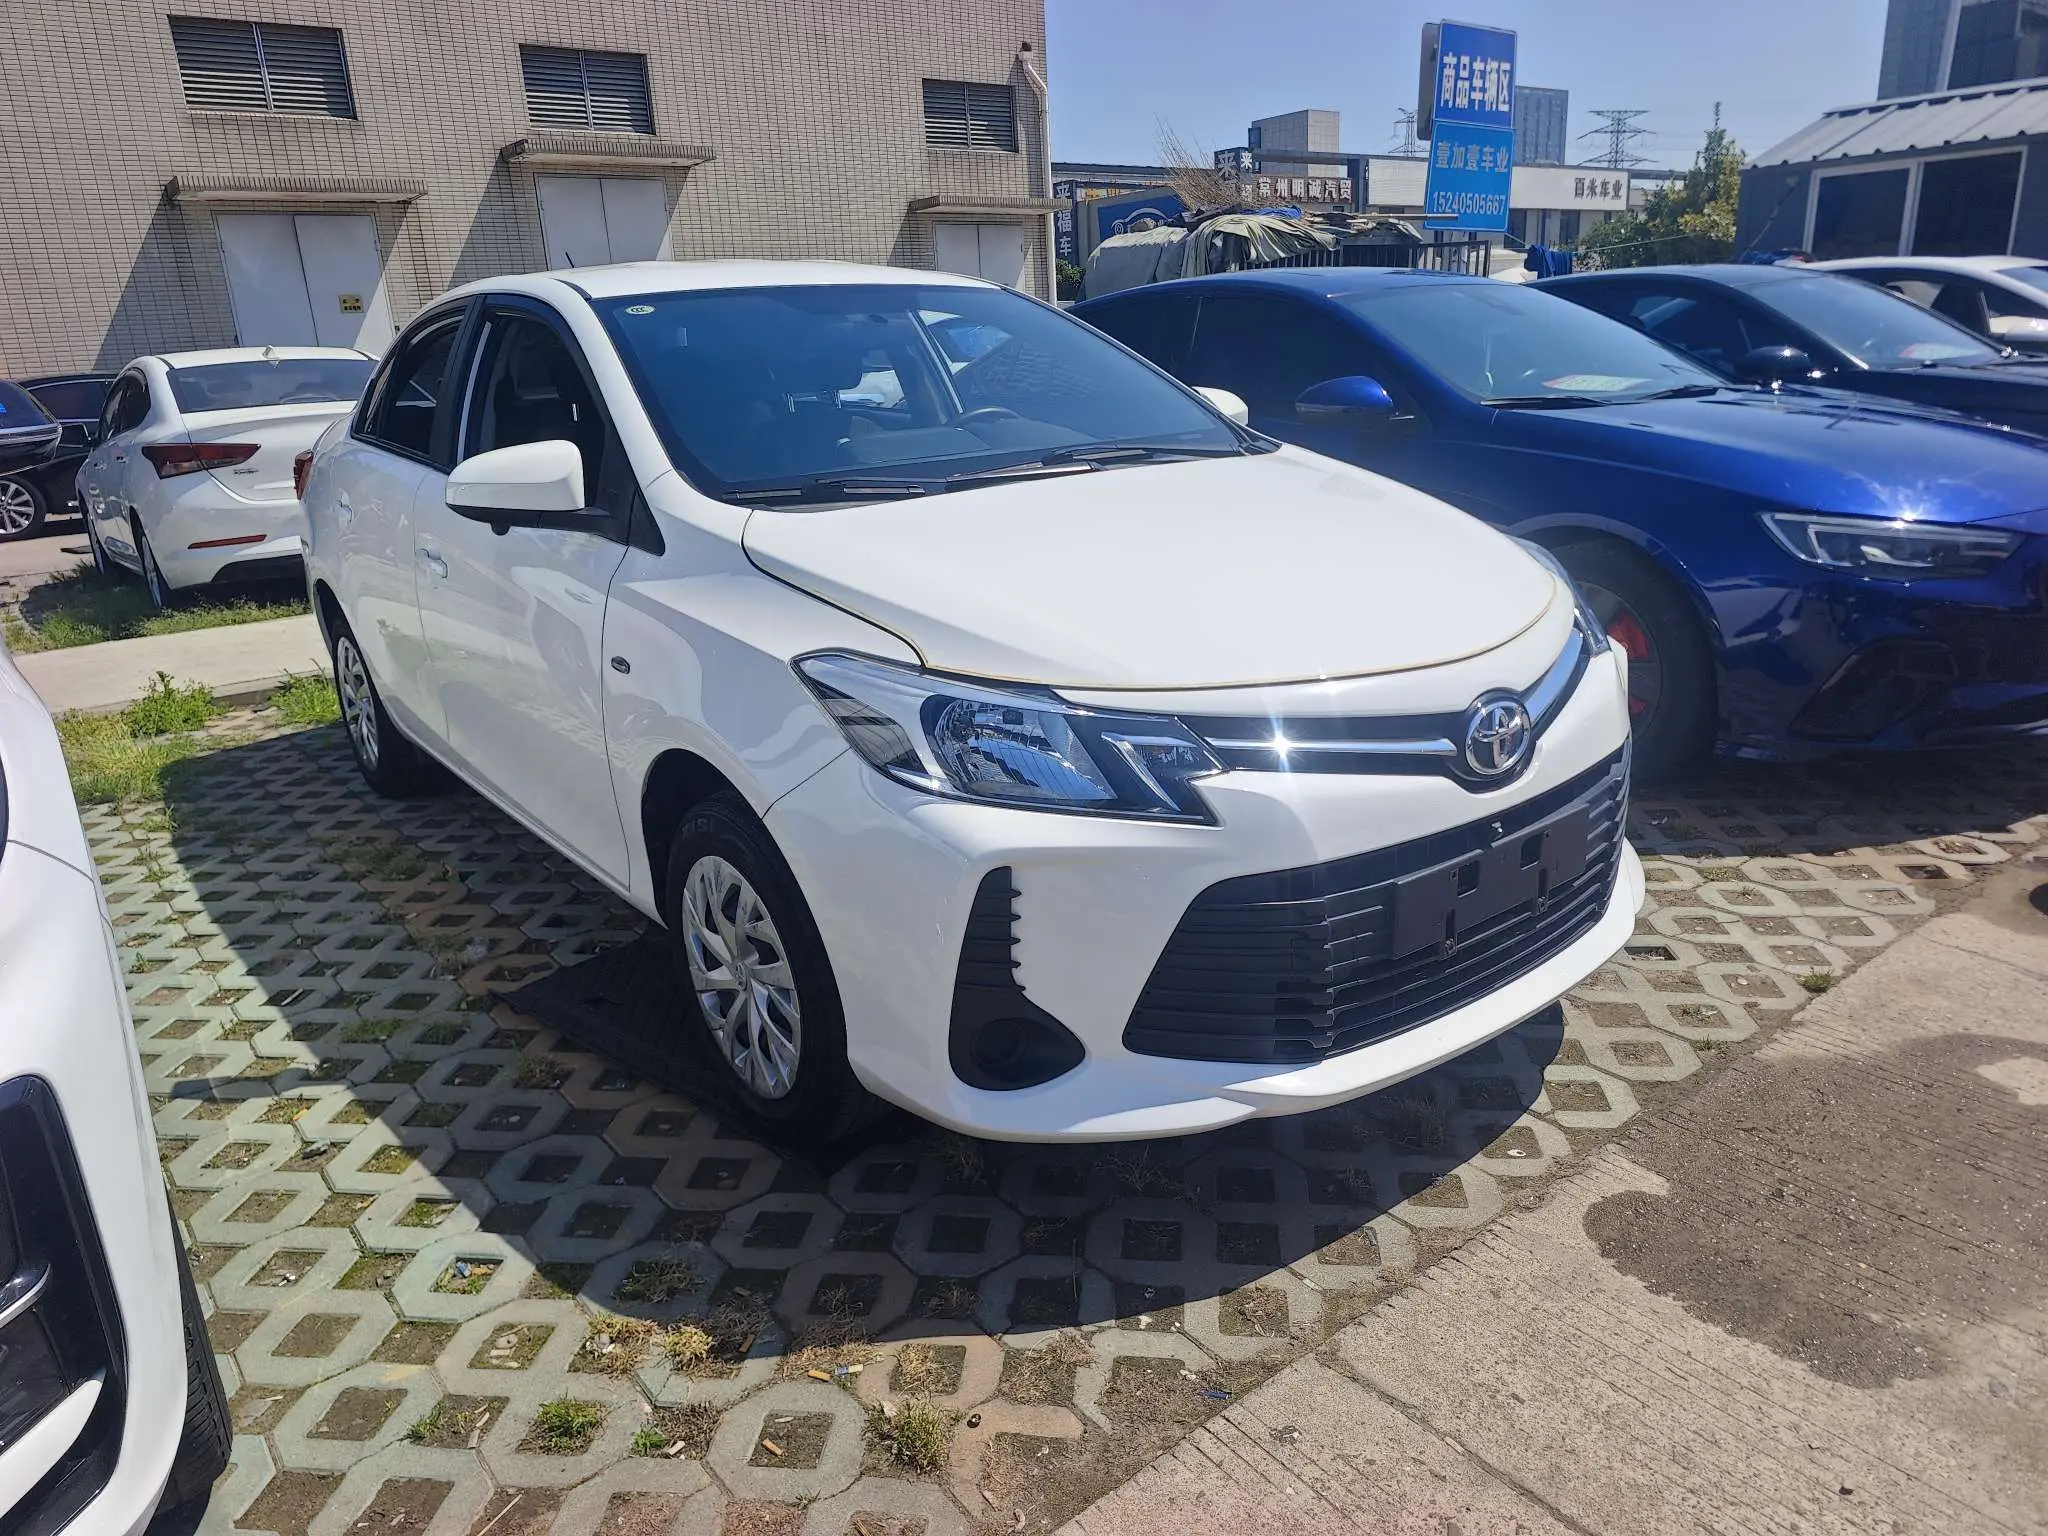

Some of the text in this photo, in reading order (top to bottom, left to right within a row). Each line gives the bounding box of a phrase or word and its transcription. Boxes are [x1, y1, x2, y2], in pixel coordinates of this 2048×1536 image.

[1440, 52, 1511, 112] 商品车辆区
[1435, 142, 1509, 173] 壹加壹车业
[1433, 191, 1505, 215] 15240505667
